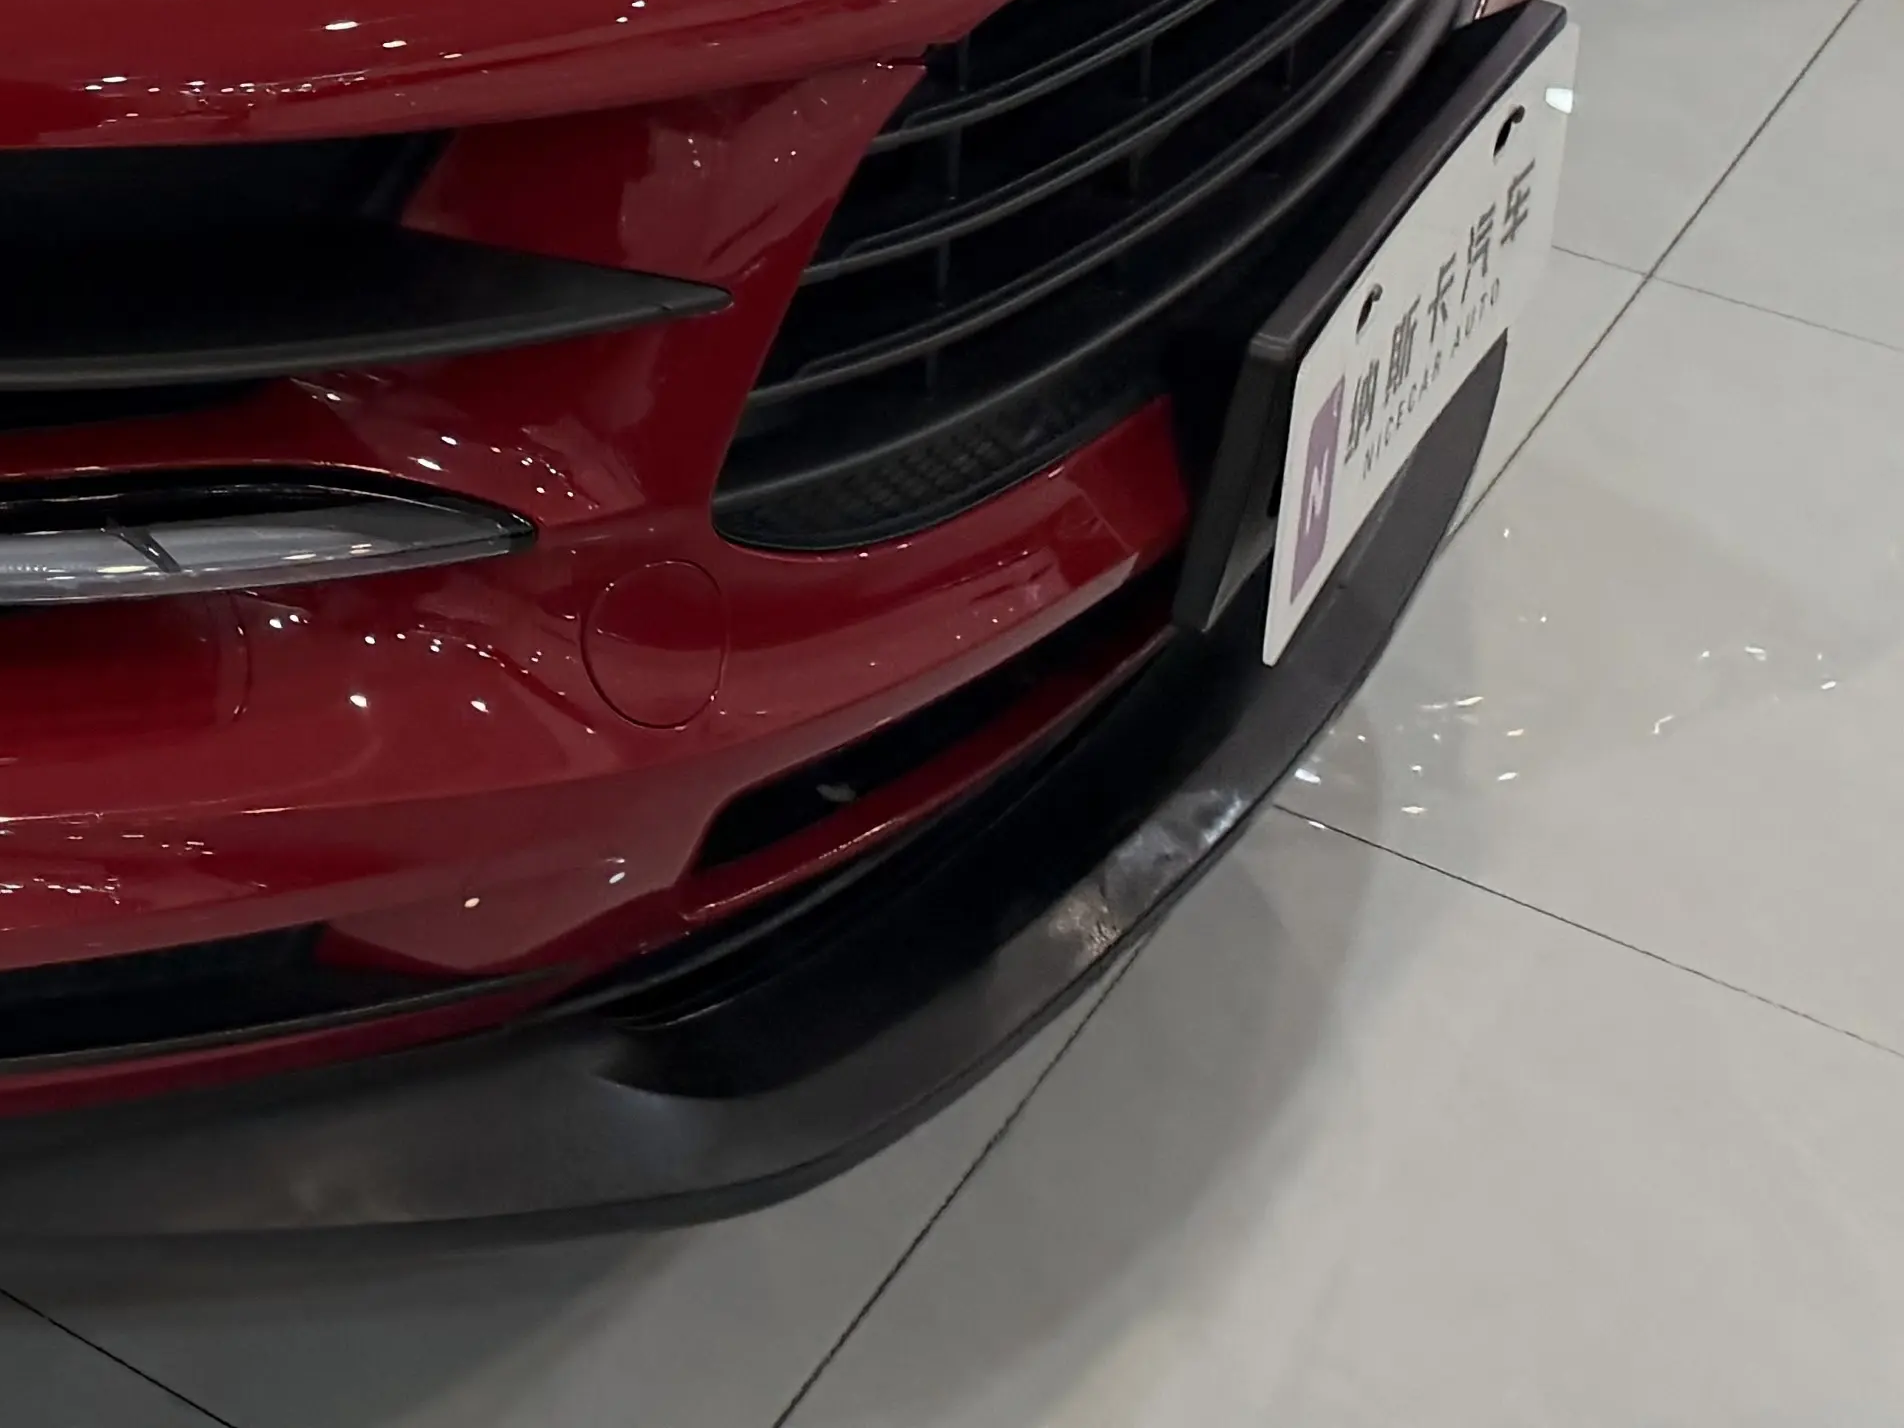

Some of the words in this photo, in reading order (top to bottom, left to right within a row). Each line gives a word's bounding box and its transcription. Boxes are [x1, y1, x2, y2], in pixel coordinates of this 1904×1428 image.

[1344, 157, 1536, 465] 纳斯卡汽车
[1362, 349, 1443, 480] NICECAR
[1450, 277, 1501, 359] AUTO
